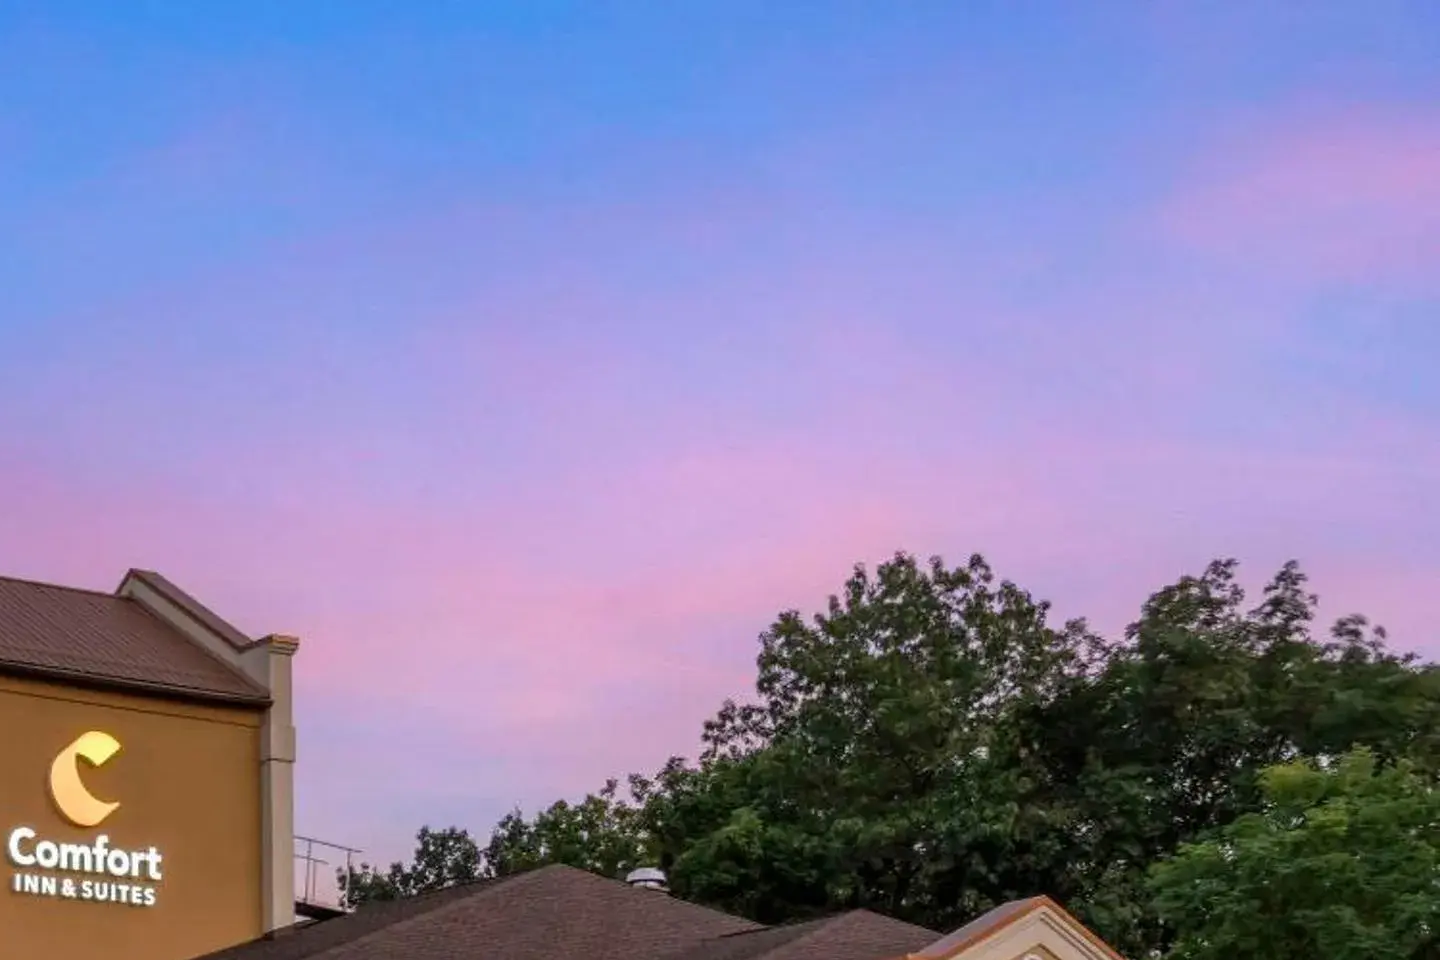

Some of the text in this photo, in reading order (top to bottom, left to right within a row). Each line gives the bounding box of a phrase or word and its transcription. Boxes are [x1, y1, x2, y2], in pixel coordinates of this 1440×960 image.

[9, 827, 162, 880] Comfort
[15, 873, 156, 906] INN & SUITES
